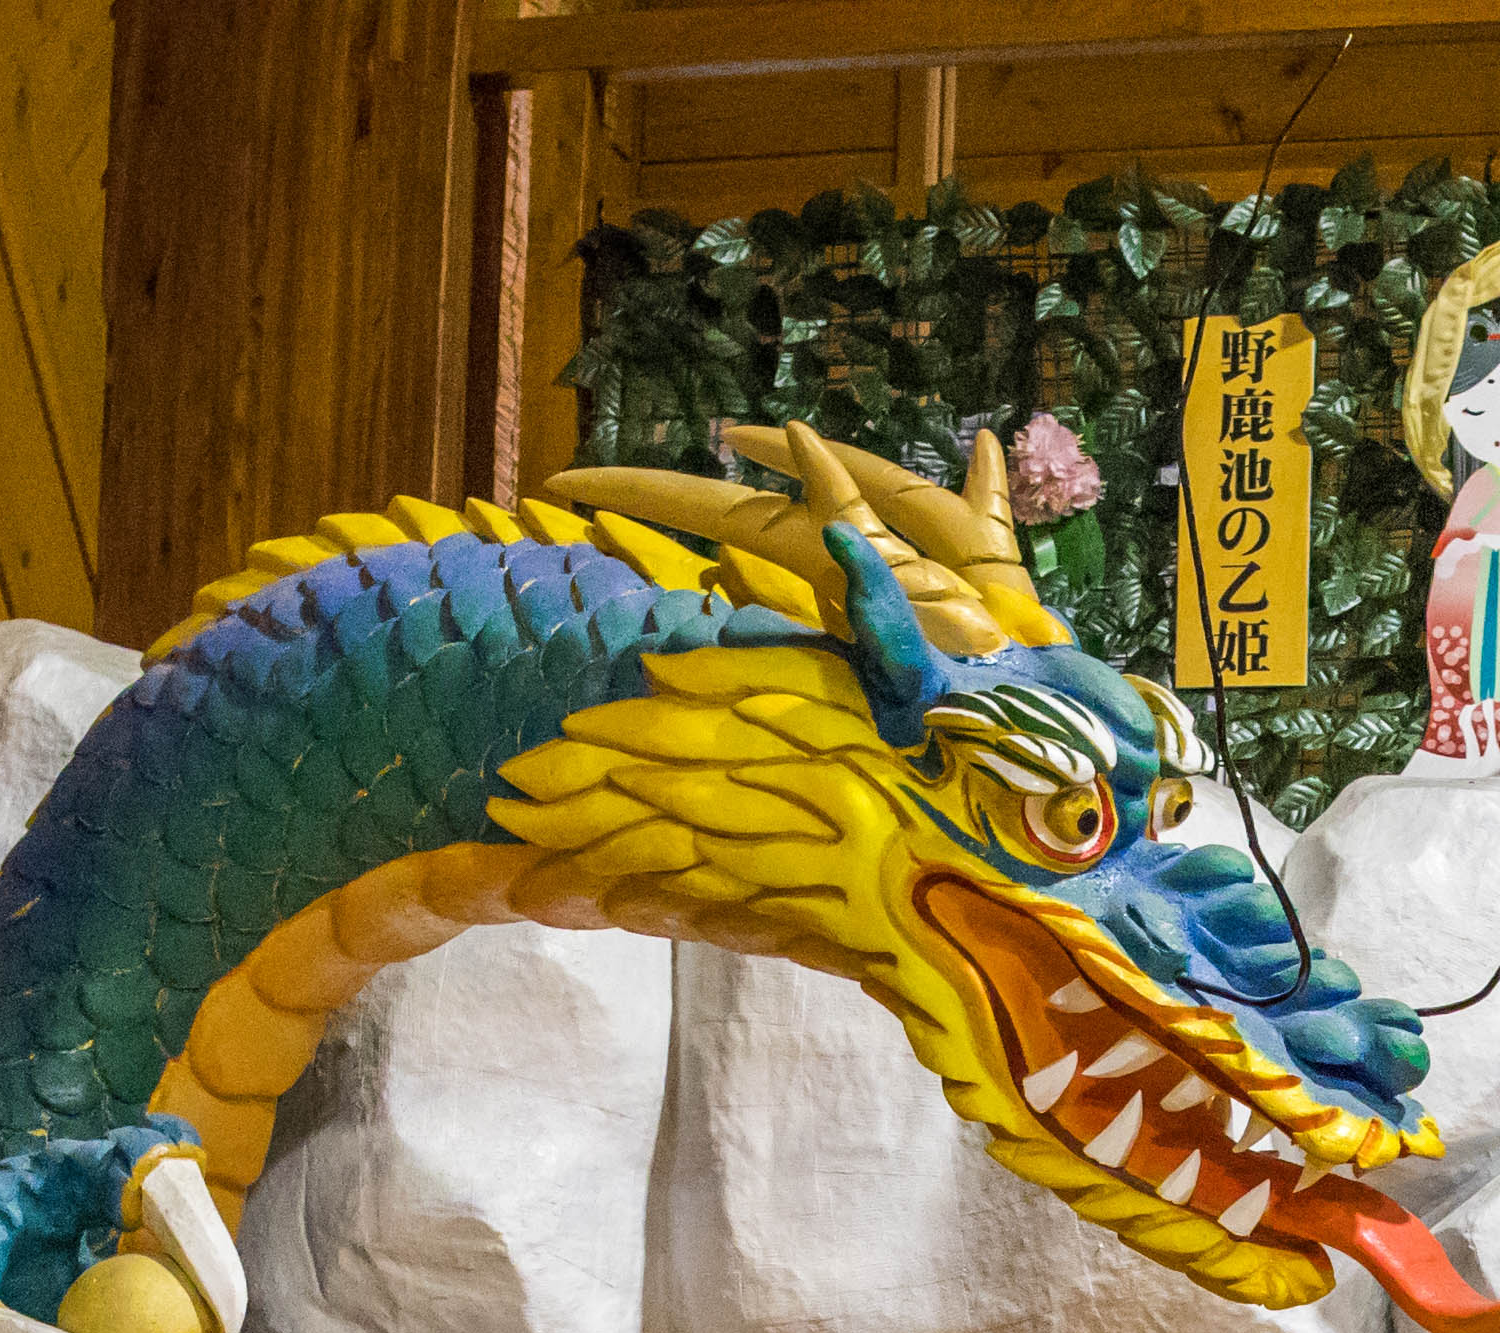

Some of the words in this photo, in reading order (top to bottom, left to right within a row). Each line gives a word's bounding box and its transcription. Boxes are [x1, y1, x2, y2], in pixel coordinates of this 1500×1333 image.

[1216, 327, 1279, 678] 野鹿池の乙姫
